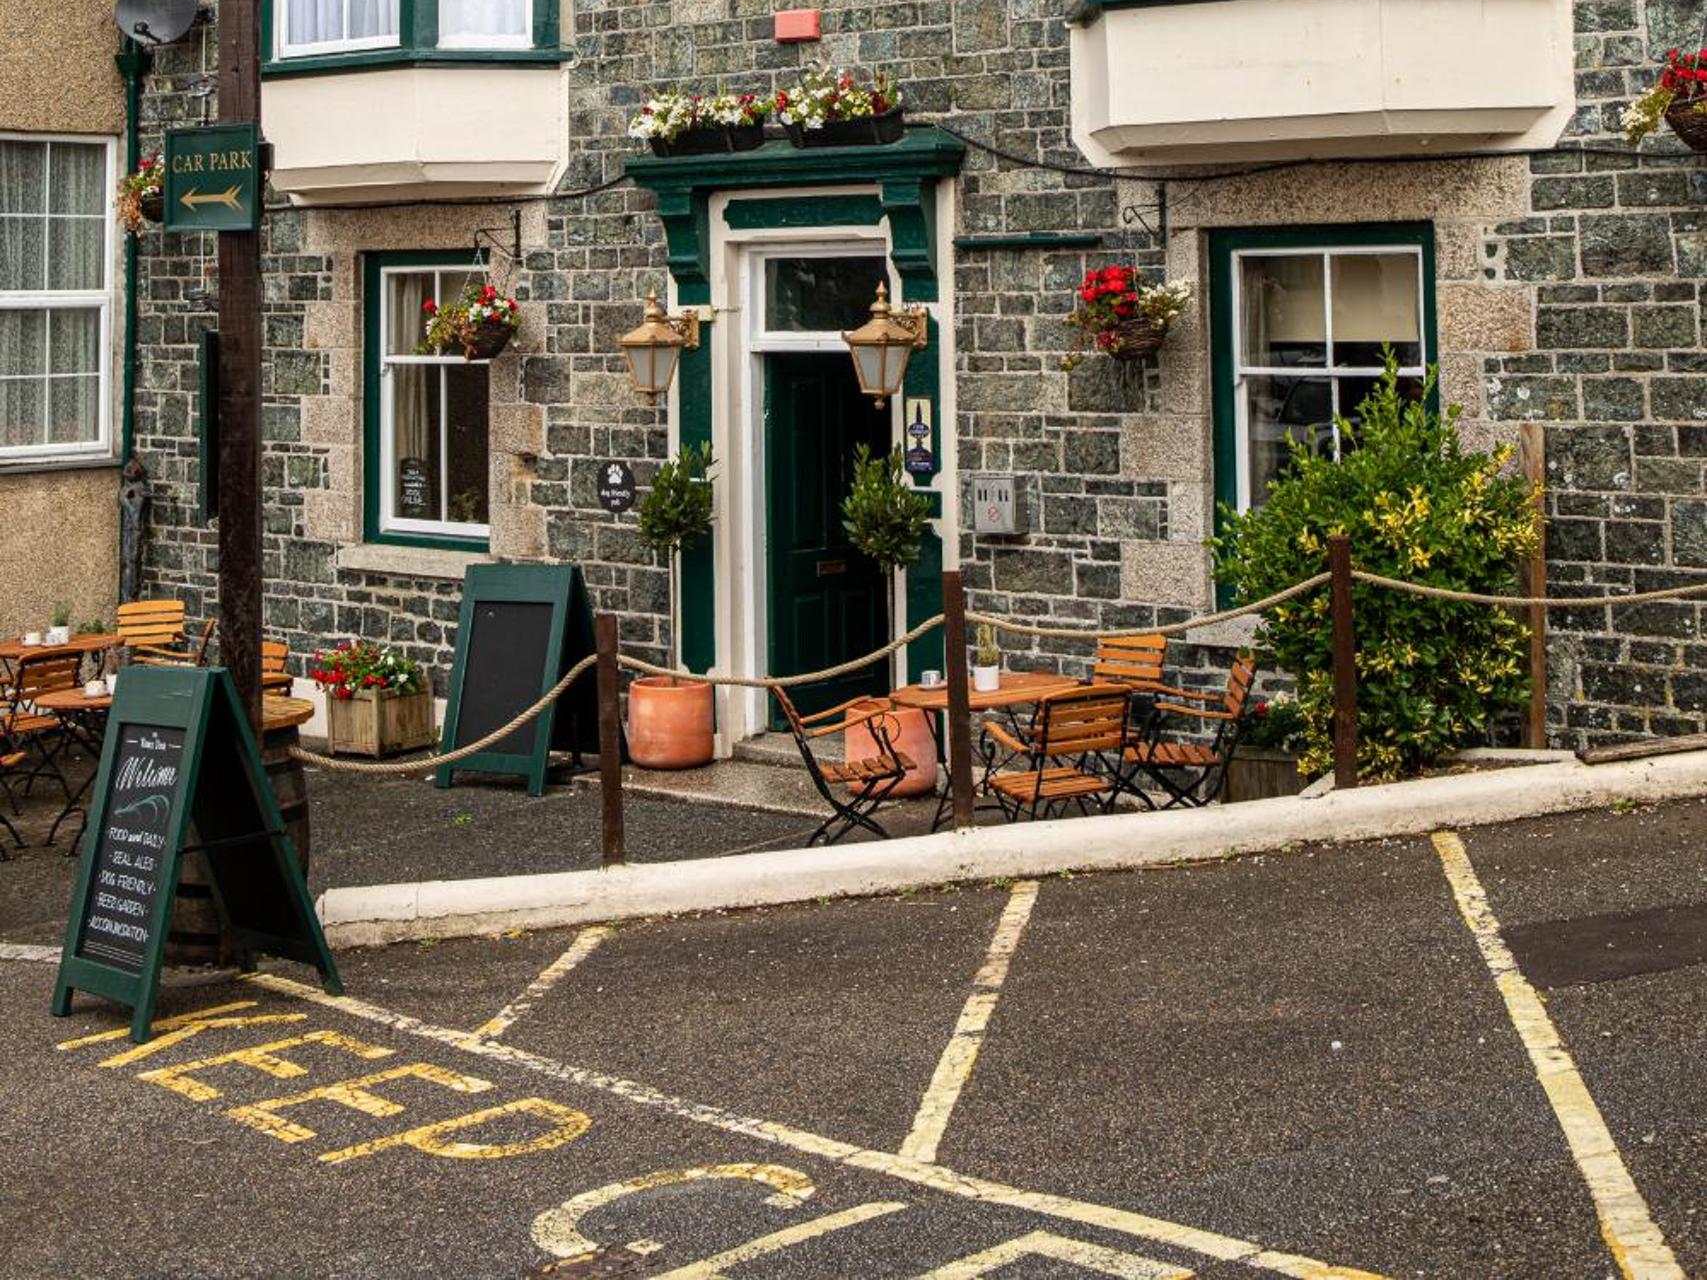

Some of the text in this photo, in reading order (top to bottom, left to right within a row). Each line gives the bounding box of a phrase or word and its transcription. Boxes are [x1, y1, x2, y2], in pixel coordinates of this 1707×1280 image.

[172, 150, 252, 173] CAR PARK
[56, 1001, 592, 1164] KEEP
